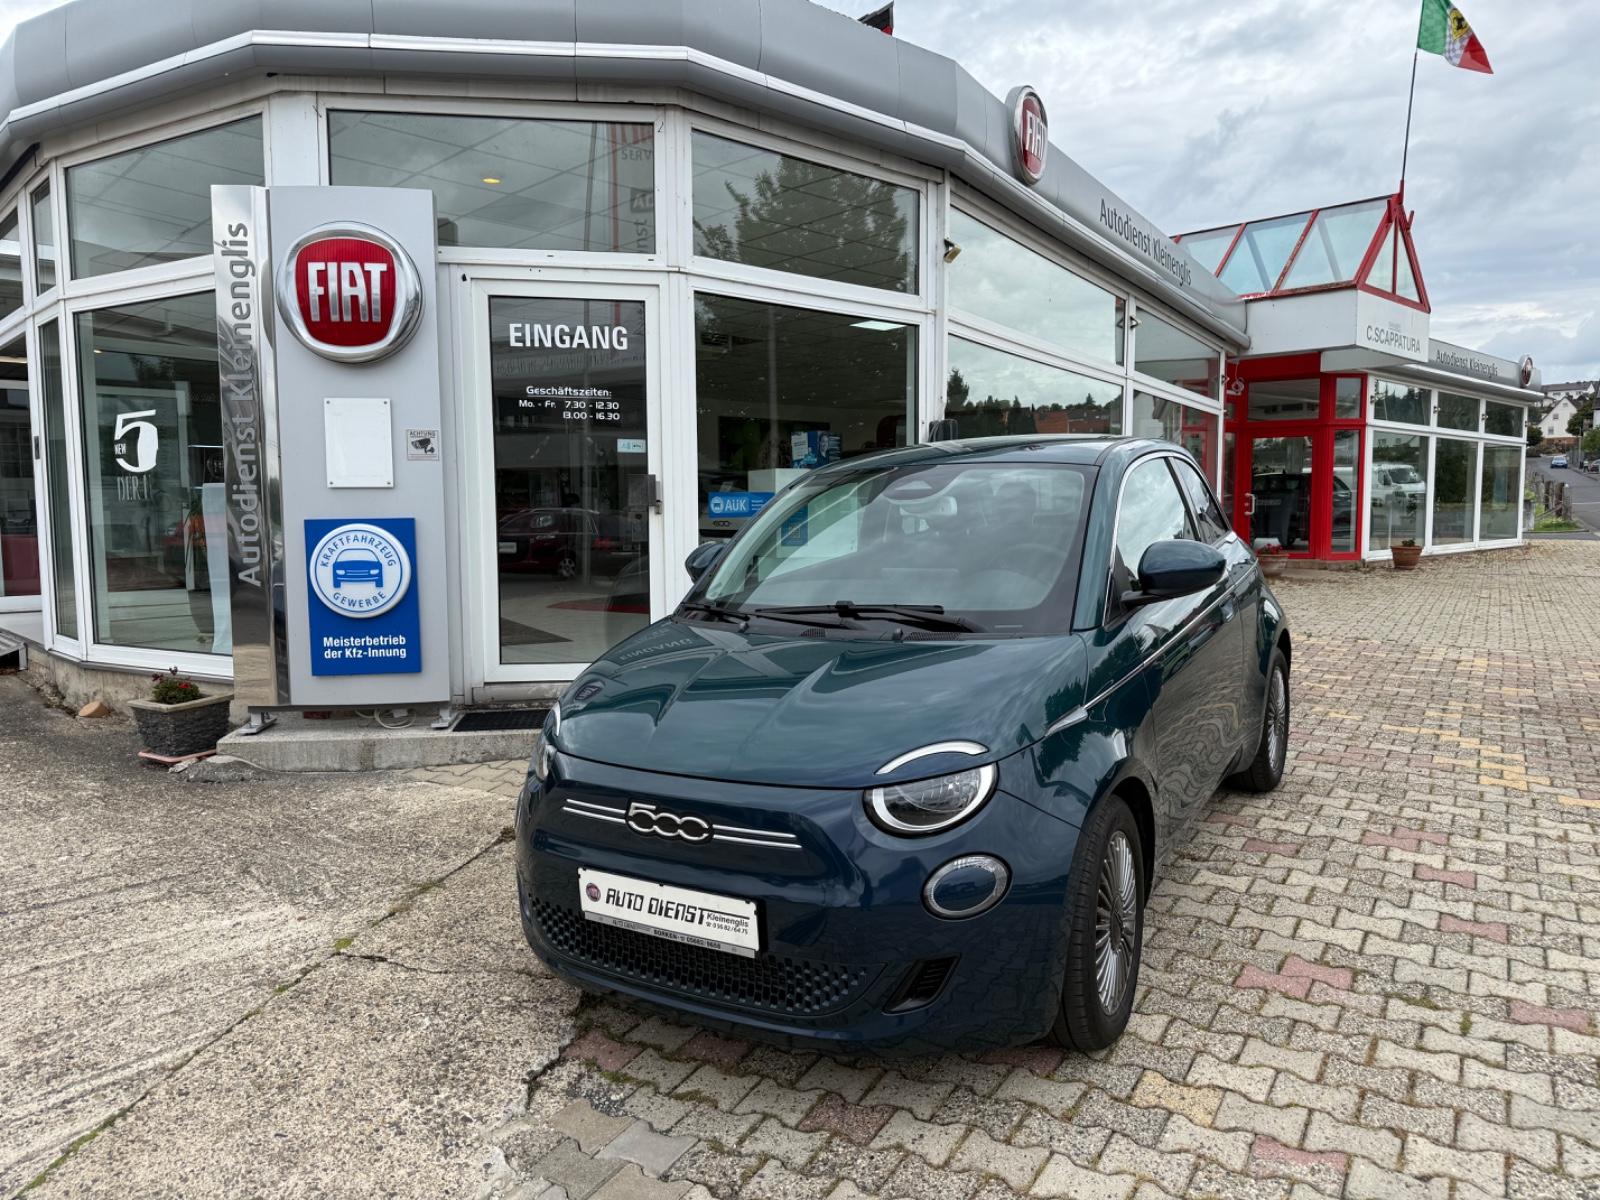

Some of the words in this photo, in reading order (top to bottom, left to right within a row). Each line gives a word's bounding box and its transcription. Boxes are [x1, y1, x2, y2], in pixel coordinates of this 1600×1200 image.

[1100, 198, 1151, 256] Autodienst
[1152, 238, 1192, 286] Kleinenglis
[307, 262, 387, 322] FIAT
[221, 222, 256, 400] Kleinenglis
[509, 323, 628, 350] EINGANG
[1436, 349, 1468, 369] Autodienst
[526, 385, 612, 397] Geschäftszeiten:
[519, 400, 535, 408] Mo.
[565, 401, 586, 409] 7.30
[595, 402, 619, 410] 12.30
[563, 411, 587, 419] 13.00
[595, 412, 620, 420] 16.30
[232, 413, 262, 587] Autodienst
[320, 534, 397, 567] KRAFTFAHRZEUG
[333, 591, 387, 608] GEWERBE
[323, 635, 406, 647] Meisterbetrieb
[324, 648, 342, 659] der
[345, 648, 407, 659] Kfz-Innung
[628, 802, 709, 841] 500
[605, 888, 645, 912] AUTO
[648, 897, 705, 925] DIENST
[707, 912, 749, 928] Kleinenglis
